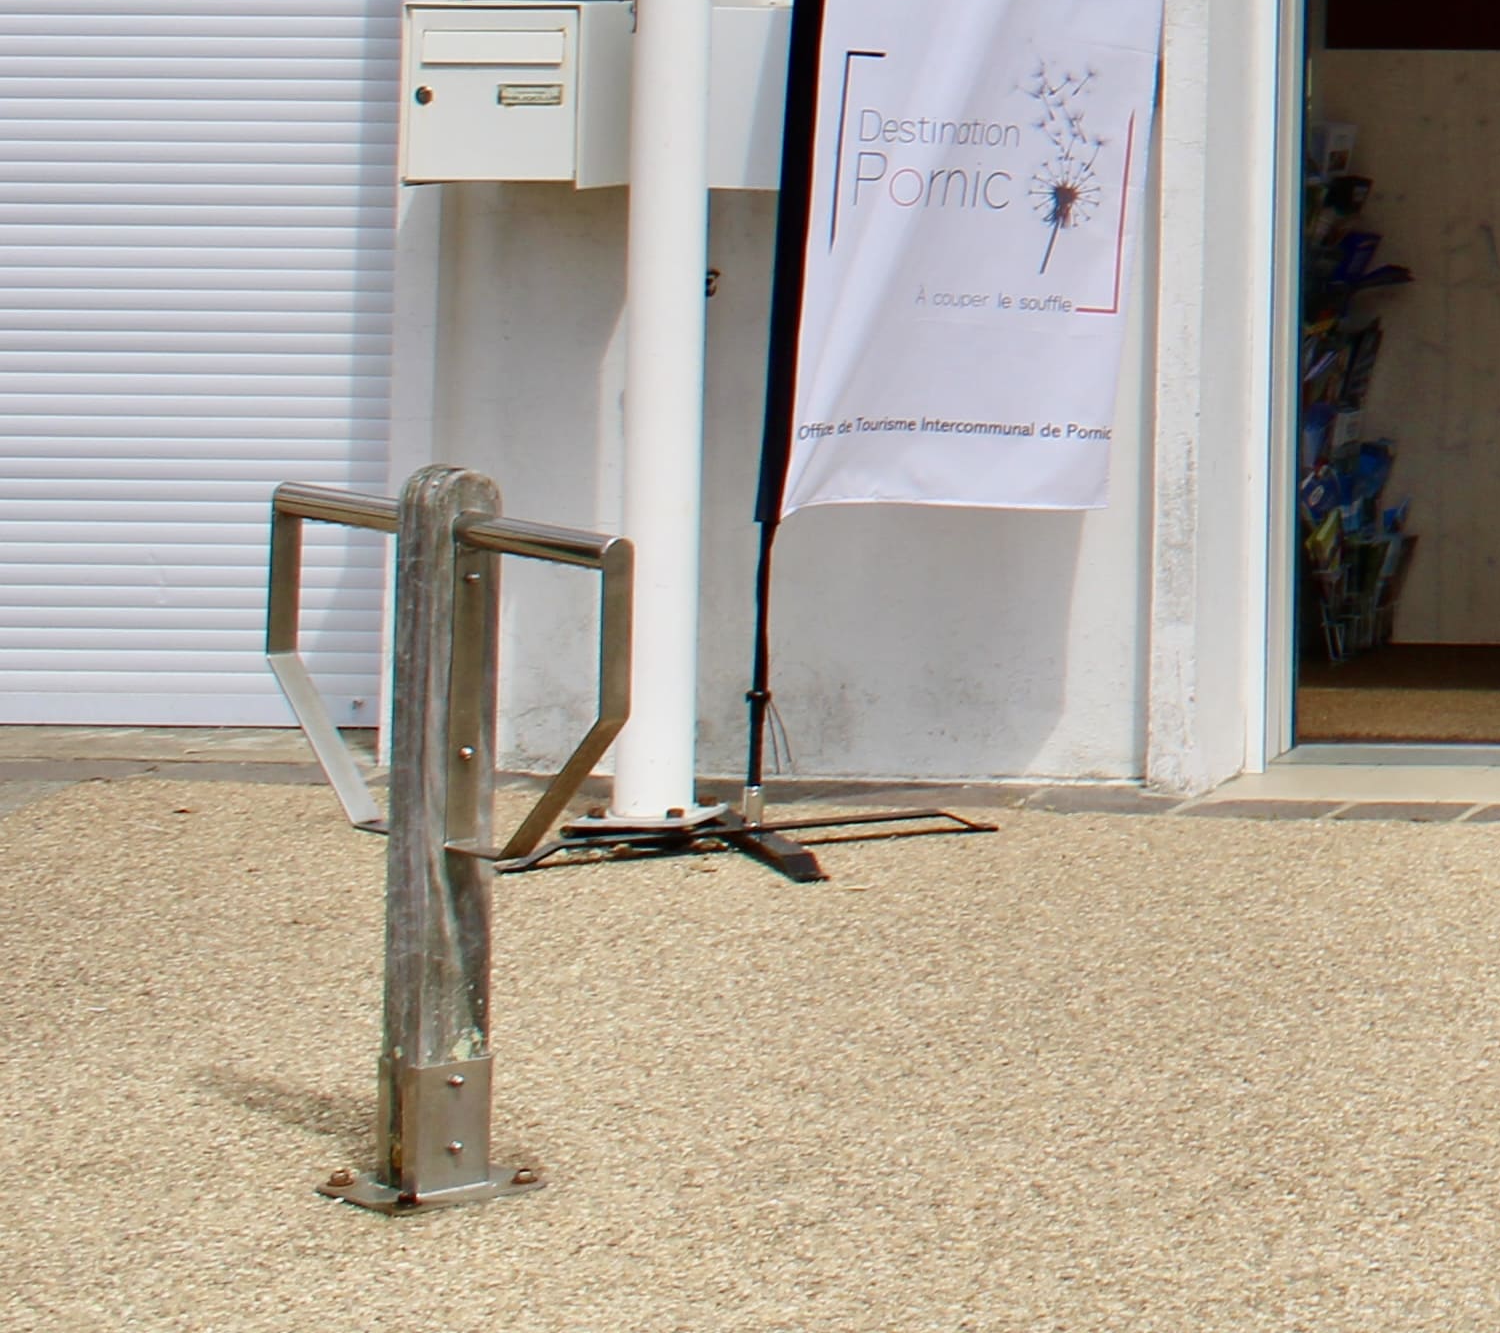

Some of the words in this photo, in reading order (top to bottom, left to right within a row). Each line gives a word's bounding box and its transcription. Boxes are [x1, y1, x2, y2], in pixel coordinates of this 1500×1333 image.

[858, 109, 1020, 147] Destination
[853, 150, 1013, 211] Pornic
[932, 290, 988, 312] couper
[997, 292, 1012, 310] le
[1019, 295, 1073, 313] souffle
[837, 420, 853, 434] de
[856, 417, 917, 433] Tourisme
[921, 416, 1035, 437] Intercommunal
[1040, 423, 1061, 438] de
[1066, 424, 1112, 440] Pornic
